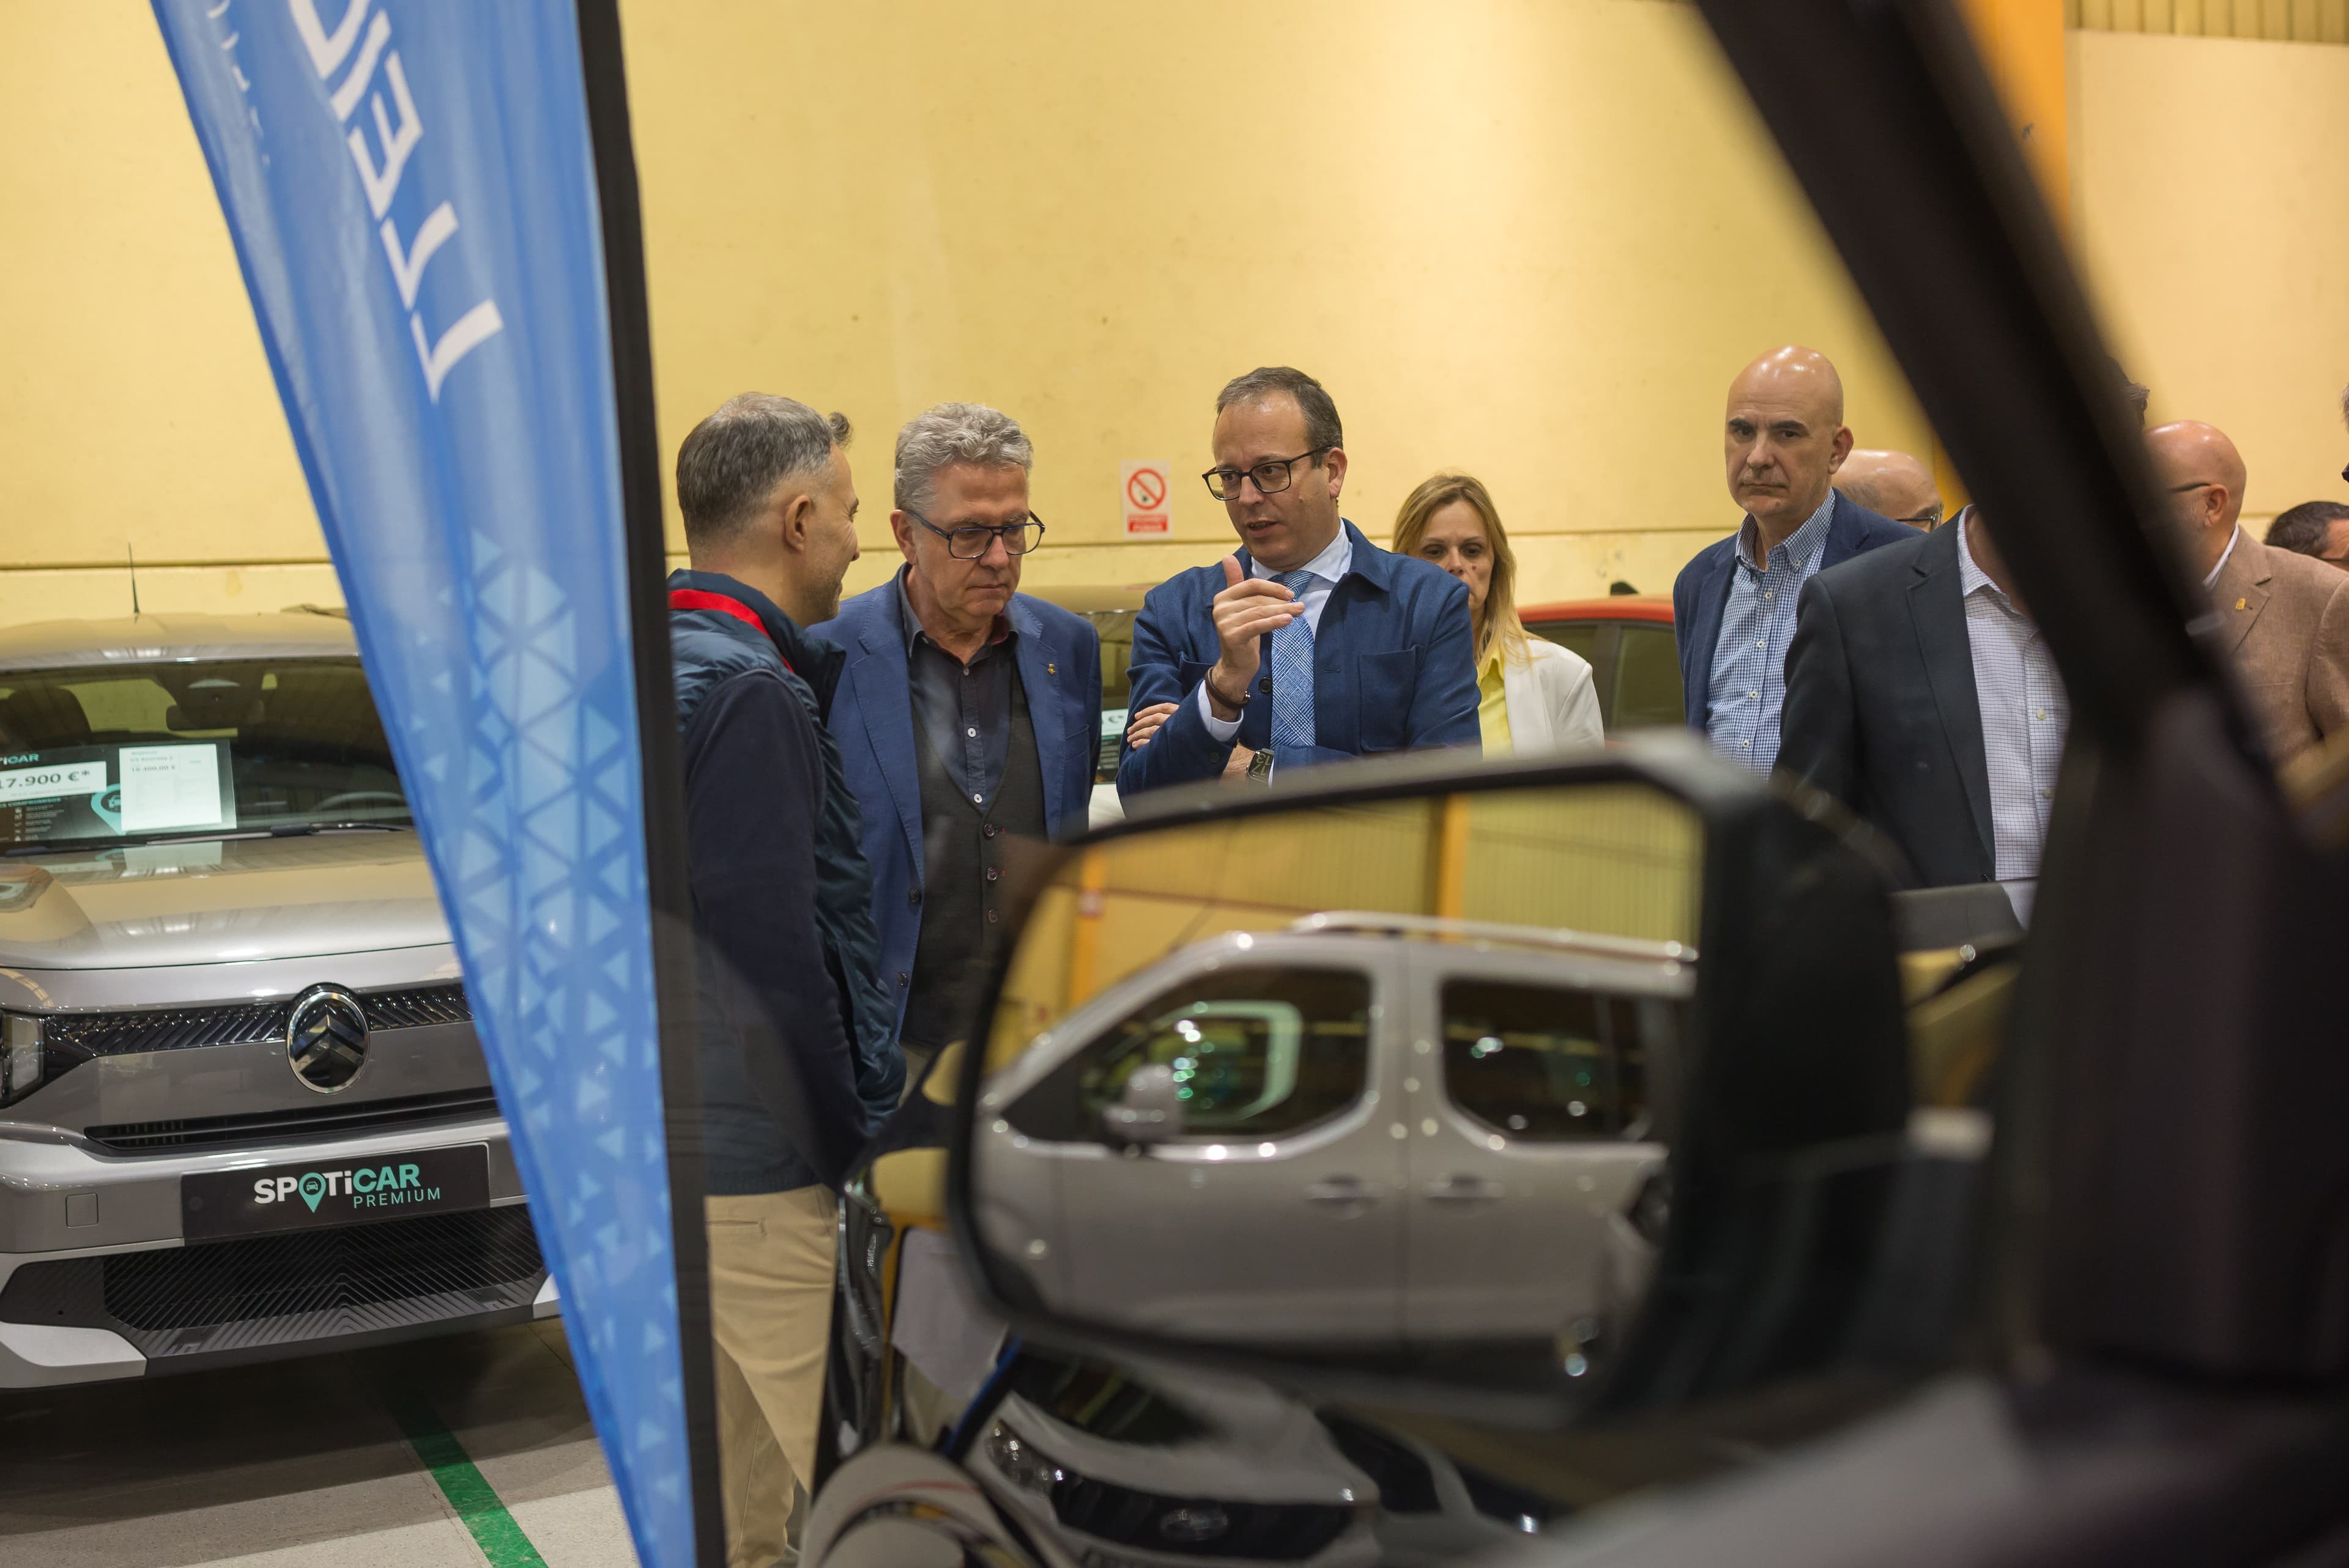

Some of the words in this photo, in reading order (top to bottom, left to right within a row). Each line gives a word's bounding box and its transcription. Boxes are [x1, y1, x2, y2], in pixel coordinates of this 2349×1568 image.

[1256, 753, 1271, 765] 13
[1251, 764, 1266, 775] 17
[354, 1188, 440, 1208] PREMIUM
